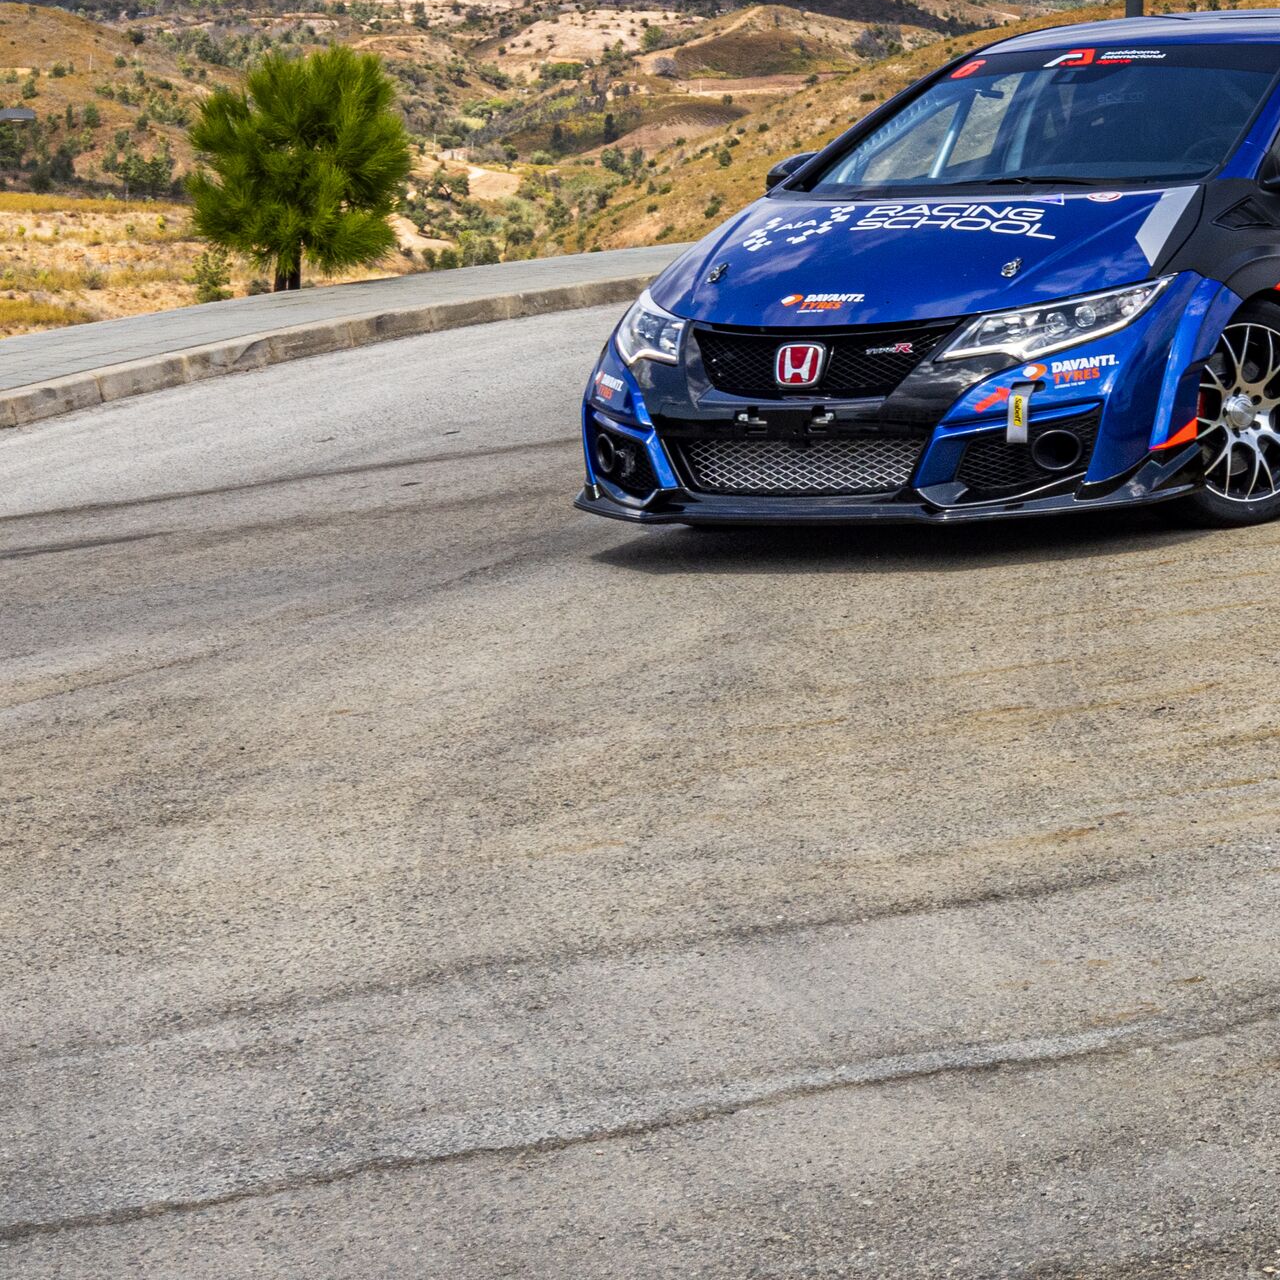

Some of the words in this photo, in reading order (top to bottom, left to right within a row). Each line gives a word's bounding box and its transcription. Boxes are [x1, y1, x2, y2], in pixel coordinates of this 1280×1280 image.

[951, 59, 987, 79] 6
[865, 204, 1045, 221] RACING
[774, 219, 817, 233] AIA
[850, 217, 1056, 240] SCHOOL
[800, 301, 843, 310] TYRES
[895, 342, 914, 353] R
[1053, 368, 1101, 384] TYRES
